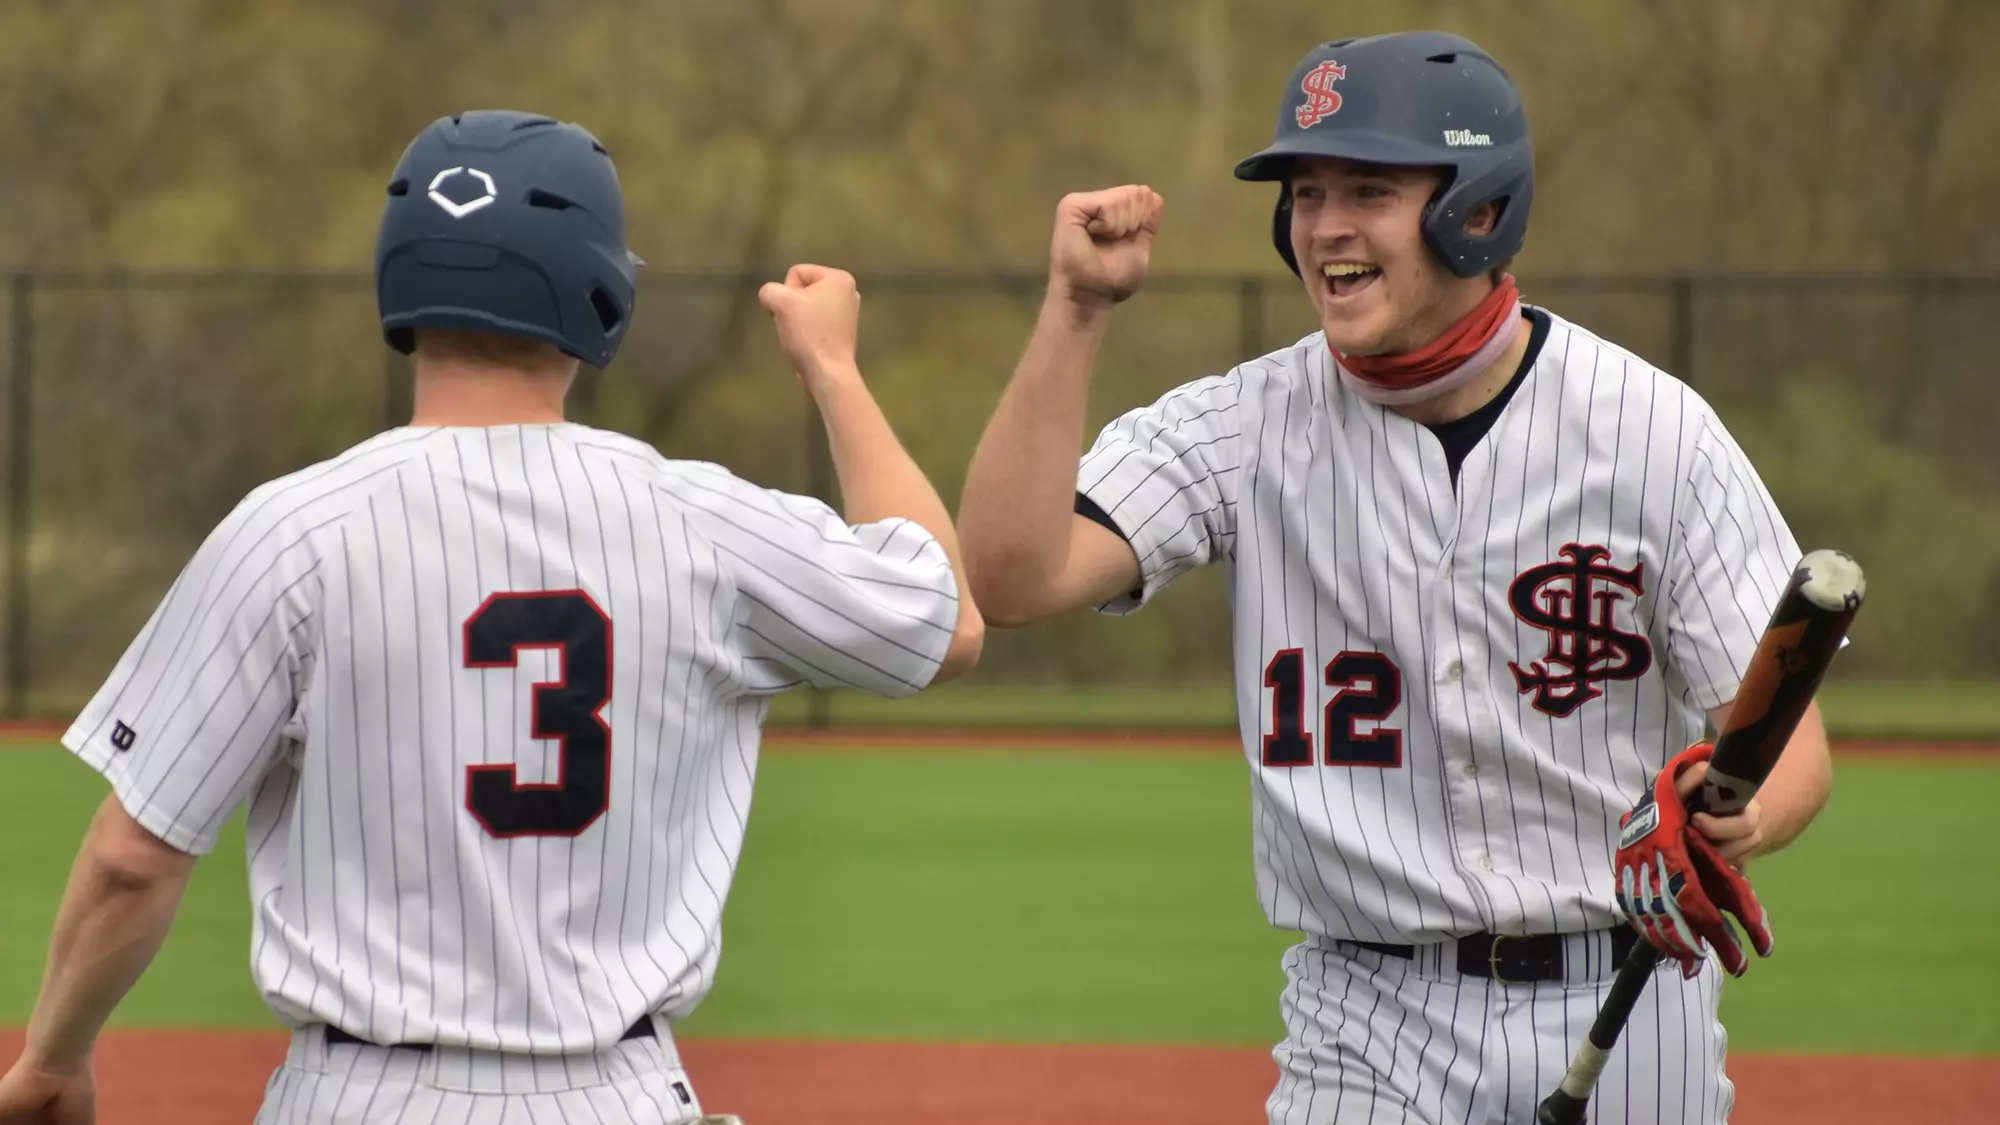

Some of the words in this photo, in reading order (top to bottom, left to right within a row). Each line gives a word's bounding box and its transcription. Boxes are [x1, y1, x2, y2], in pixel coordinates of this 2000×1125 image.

[1443, 129, 1490, 146] Wilson
[463, 589, 613, 839] 3
[1263, 647, 1402, 768] 12
